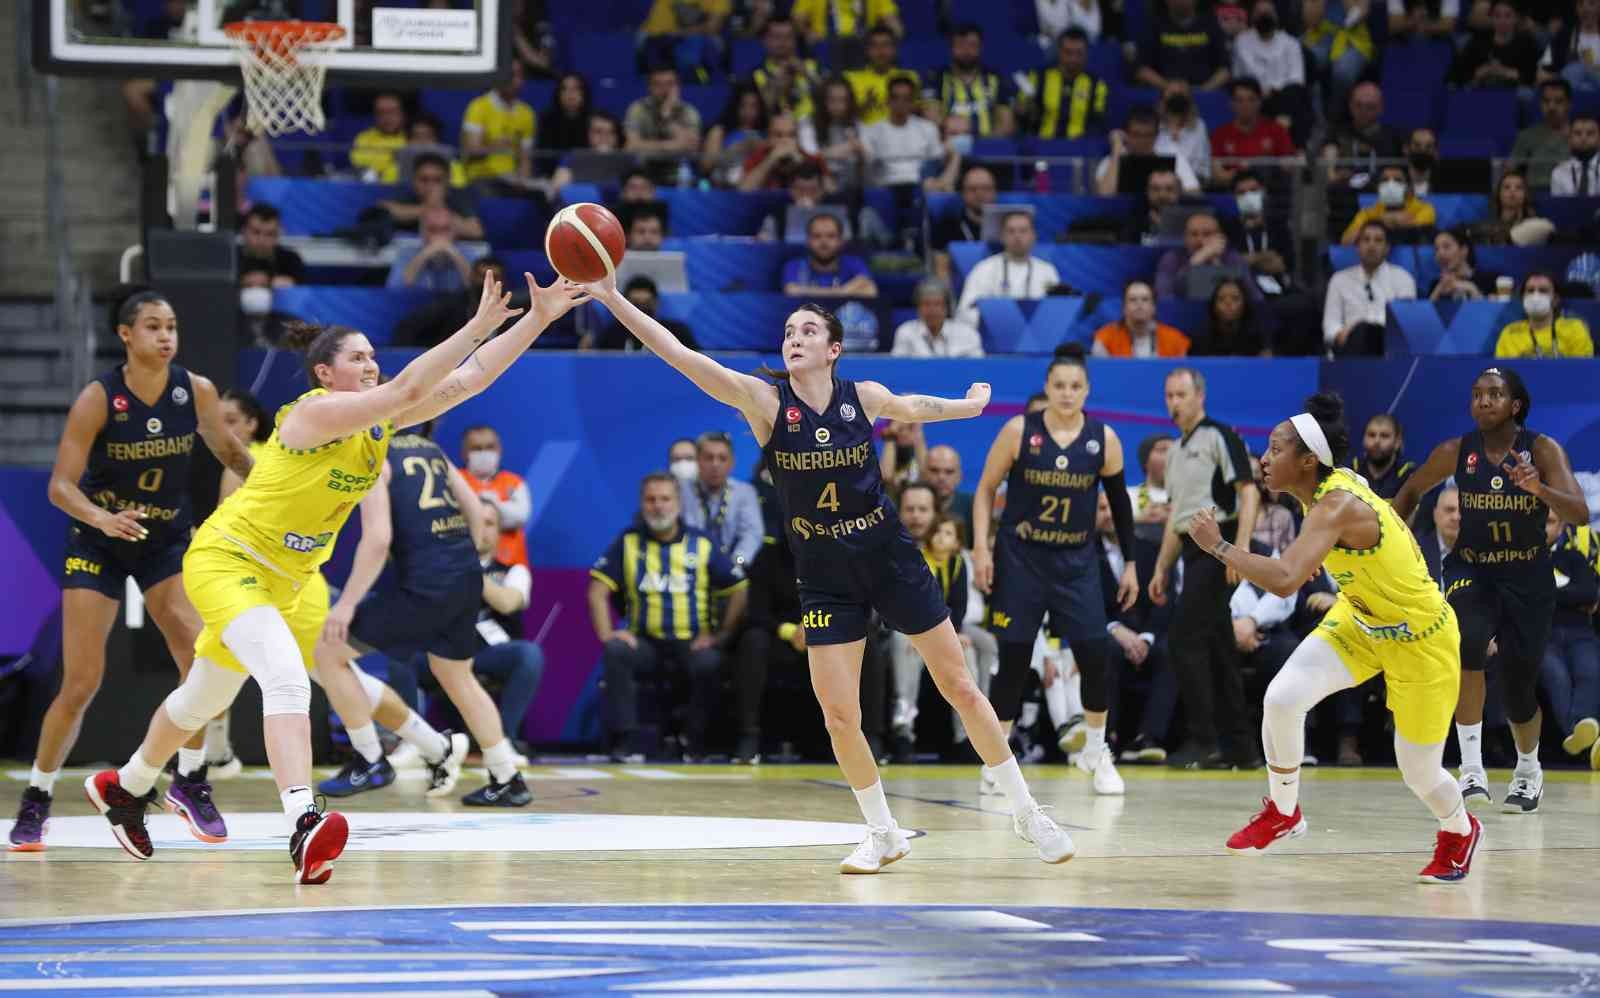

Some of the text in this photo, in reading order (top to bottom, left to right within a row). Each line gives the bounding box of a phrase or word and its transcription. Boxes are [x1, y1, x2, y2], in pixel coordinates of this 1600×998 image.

[107, 433, 194, 460] FENERBAHÇ
[775, 442, 869, 470] FENERBAHÇE
[138, 468, 163, 492] 0
[816, 482, 840, 512] 4
[1039, 496, 1071, 523] 21
[815, 506, 885, 539] SFİPORT
[1487, 521, 1512, 543] 11
[803, 609, 832, 628] etir
